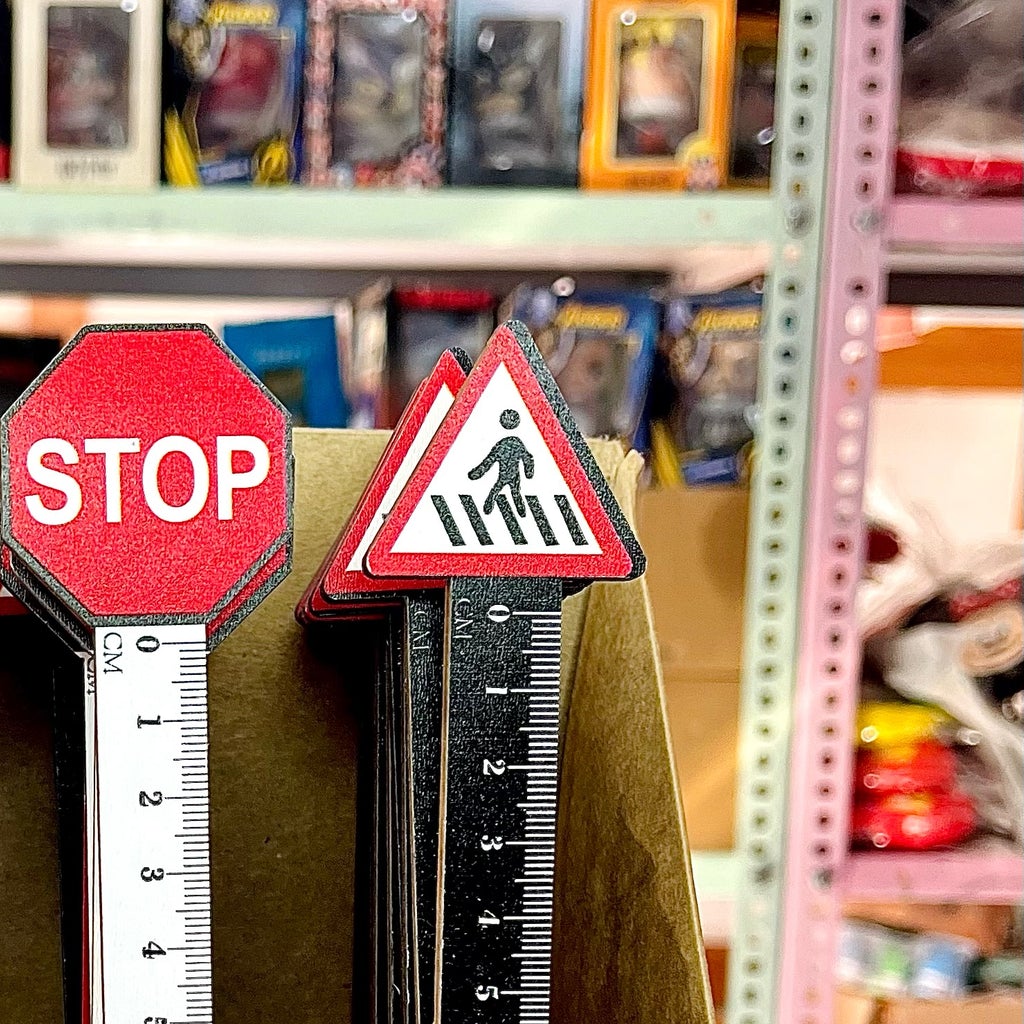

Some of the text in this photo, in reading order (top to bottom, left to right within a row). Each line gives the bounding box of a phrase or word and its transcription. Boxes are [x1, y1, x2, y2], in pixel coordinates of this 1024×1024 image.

[24, 434, 271, 525] STOP
[487, 604, 511, 623] 0
[135, 634, 161, 653] 0
[102, 632, 124, 675] CM
[485, 686, 509, 695] 1
[482, 758, 506, 776] 2
[138, 790, 163, 807] 2
[479, 834, 504, 851] 3
[140, 866, 165, 883] 3
[477, 909, 501, 929] 4
[142, 940, 167, 960] 4
[475, 984, 499, 1002] 5
